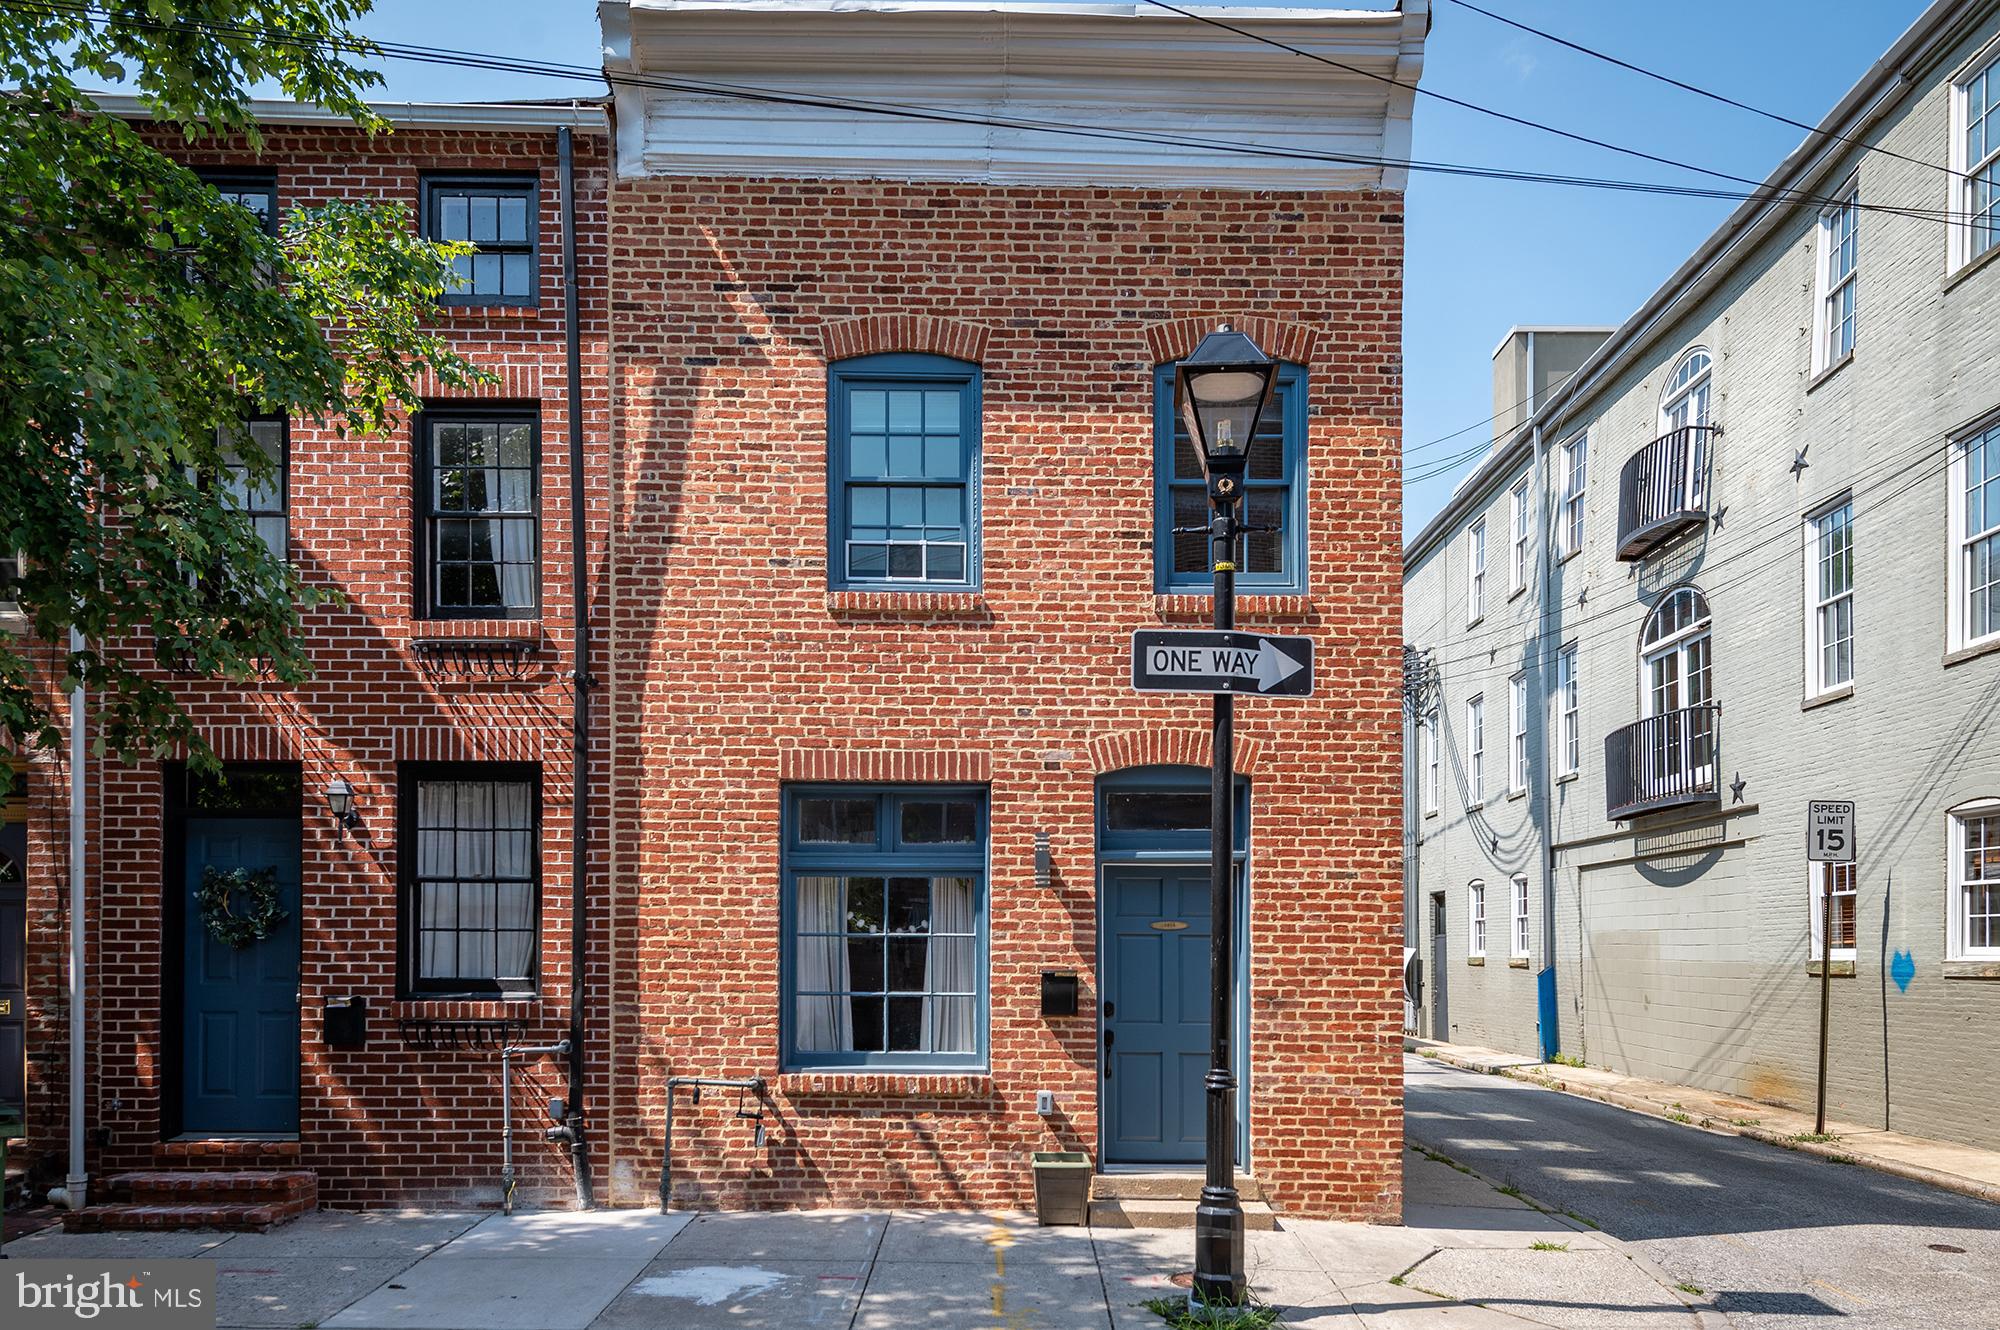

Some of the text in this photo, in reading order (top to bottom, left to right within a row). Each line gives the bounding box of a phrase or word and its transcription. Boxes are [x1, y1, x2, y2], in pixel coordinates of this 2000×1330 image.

[1153, 650, 1259, 674] ONE WAY
[1813, 804, 1850, 813] SPEED
[1817, 816, 1845, 824] LIMIT
[1817, 829, 1845, 851] 15
